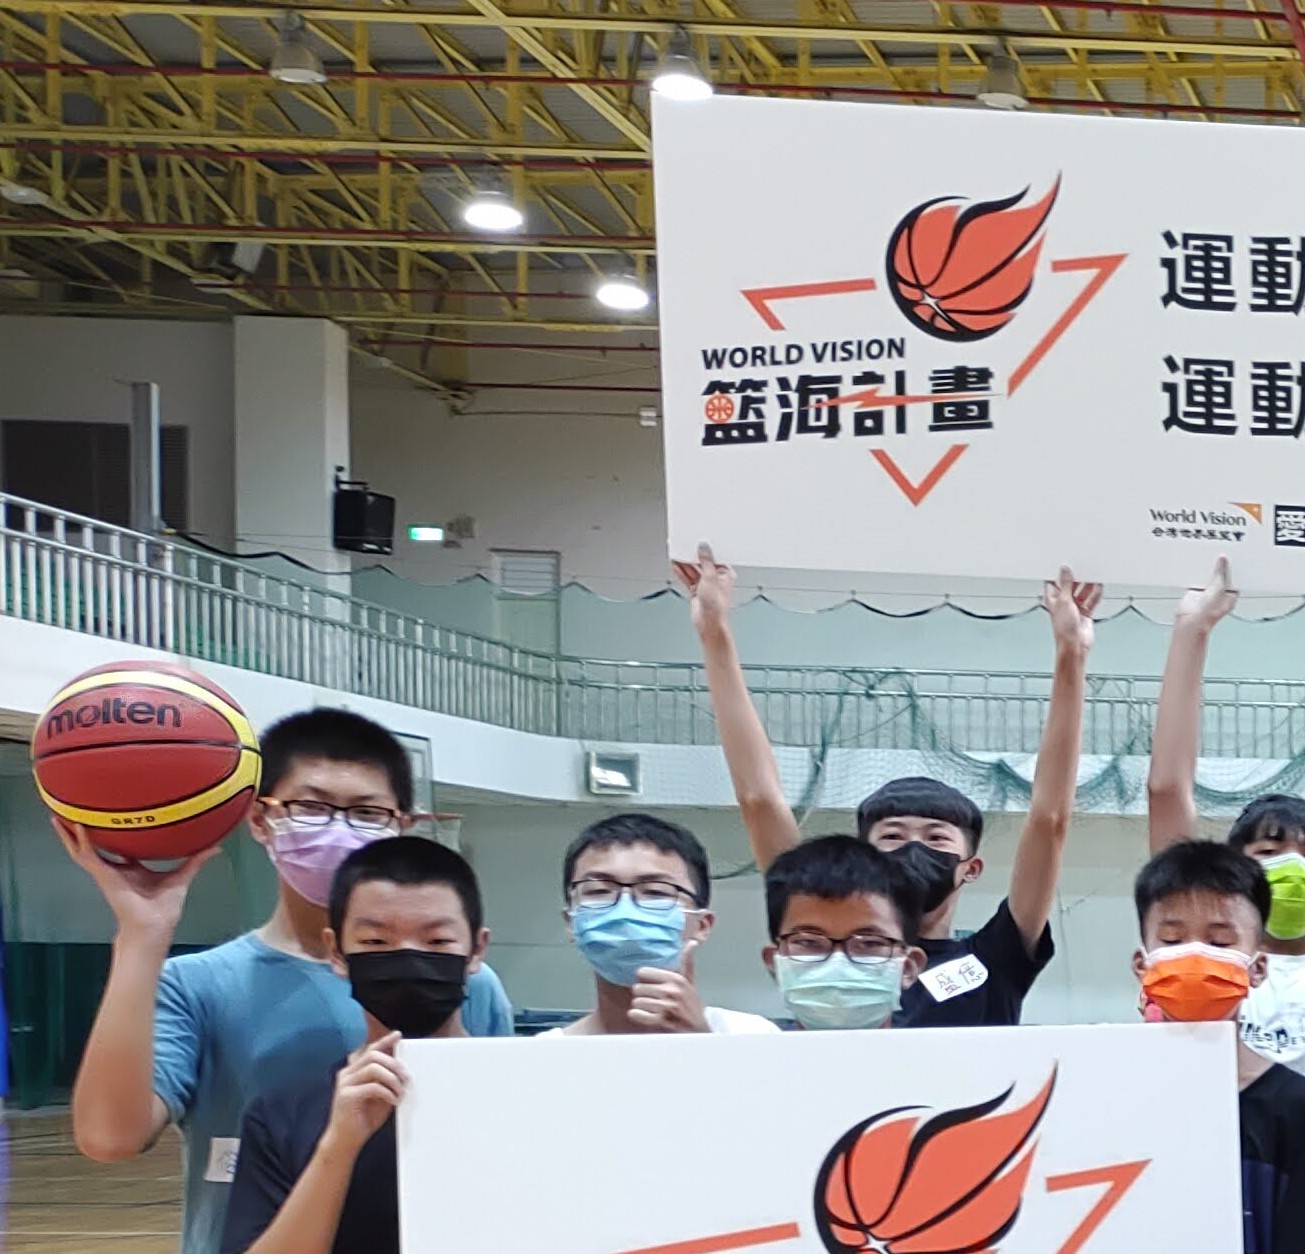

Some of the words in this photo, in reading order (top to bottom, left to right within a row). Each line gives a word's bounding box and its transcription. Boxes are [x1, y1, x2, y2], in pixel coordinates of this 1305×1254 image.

[702, 345, 803, 371] WORLD
[811, 337, 906, 365] VISION
[702, 365, 996, 448] 籃海計畫
[1149, 508, 1196, 524] World
[1200, 511, 1247, 526] Vision
[47, 697, 182, 739] molten
